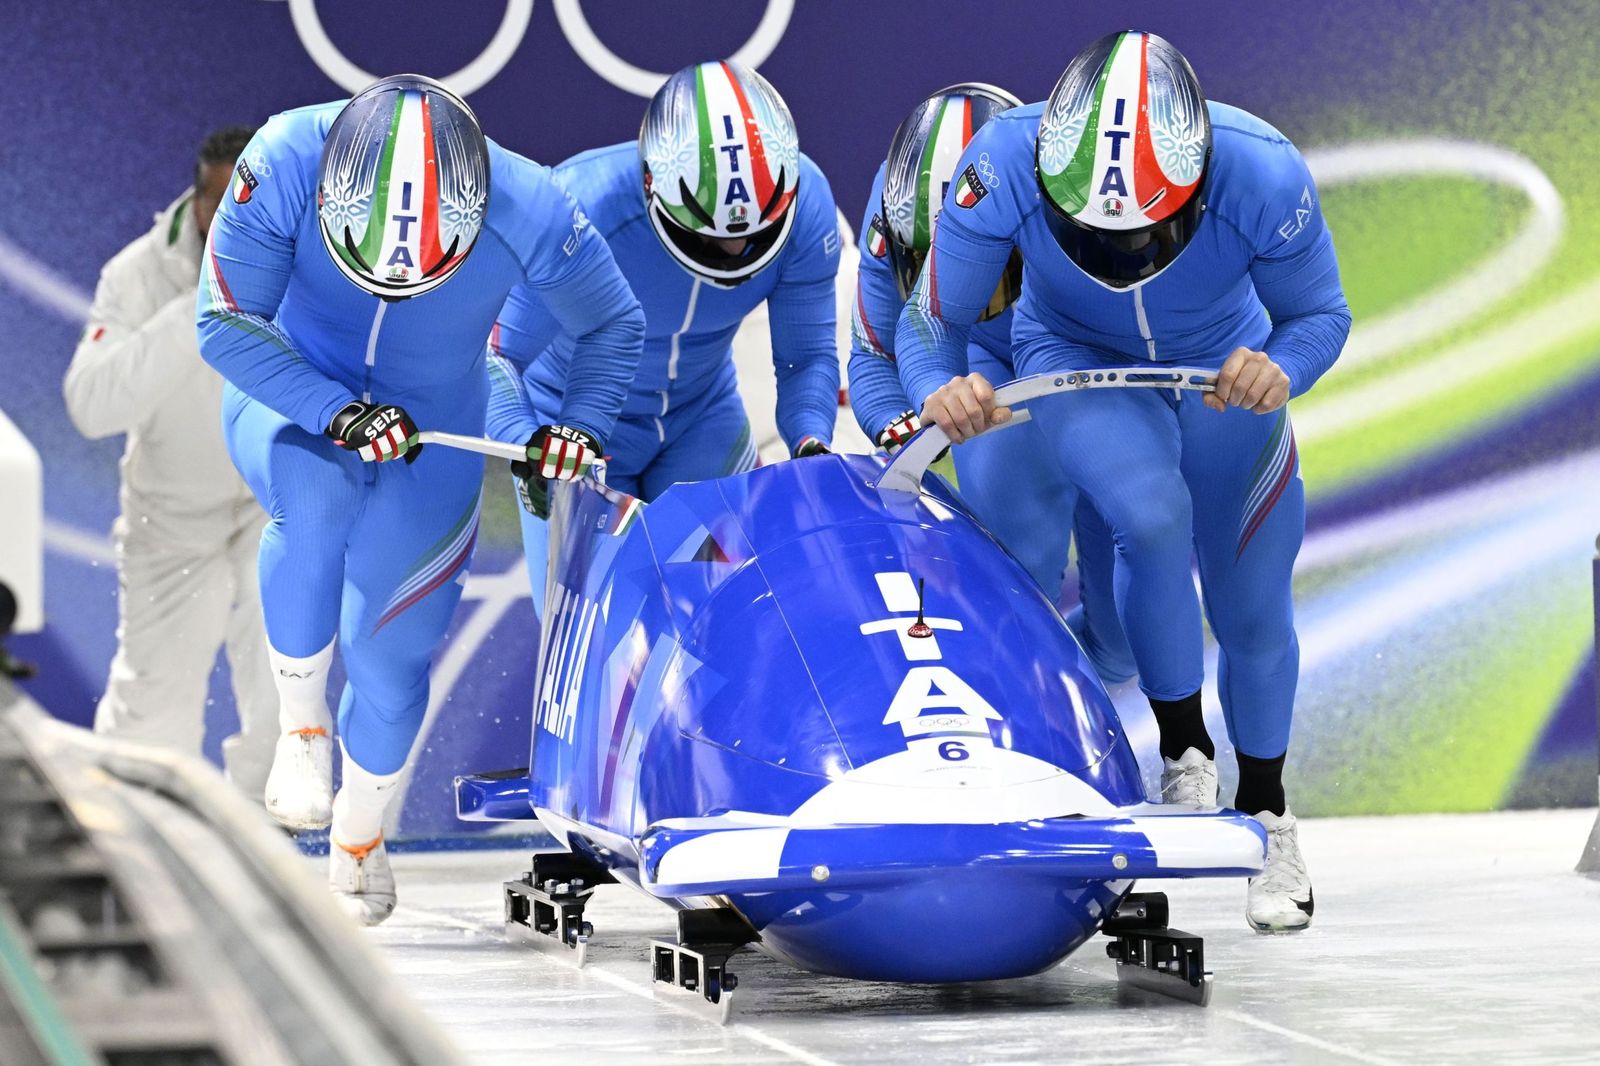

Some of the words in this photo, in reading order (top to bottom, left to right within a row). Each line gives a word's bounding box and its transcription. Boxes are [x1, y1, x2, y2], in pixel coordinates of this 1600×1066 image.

[720, 115, 750, 205] ITA
[1099, 98, 1130, 197] ITA
[968, 166, 984, 194] ITALIA
[386, 182, 417, 267] ITA
[1279, 185, 1312, 240] EA7
[364, 408, 400, 440] SEIZ
[550, 425, 590, 449] SEIZ
[859, 571, 1004, 725] ITA
[938, 741, 970, 761] 6
